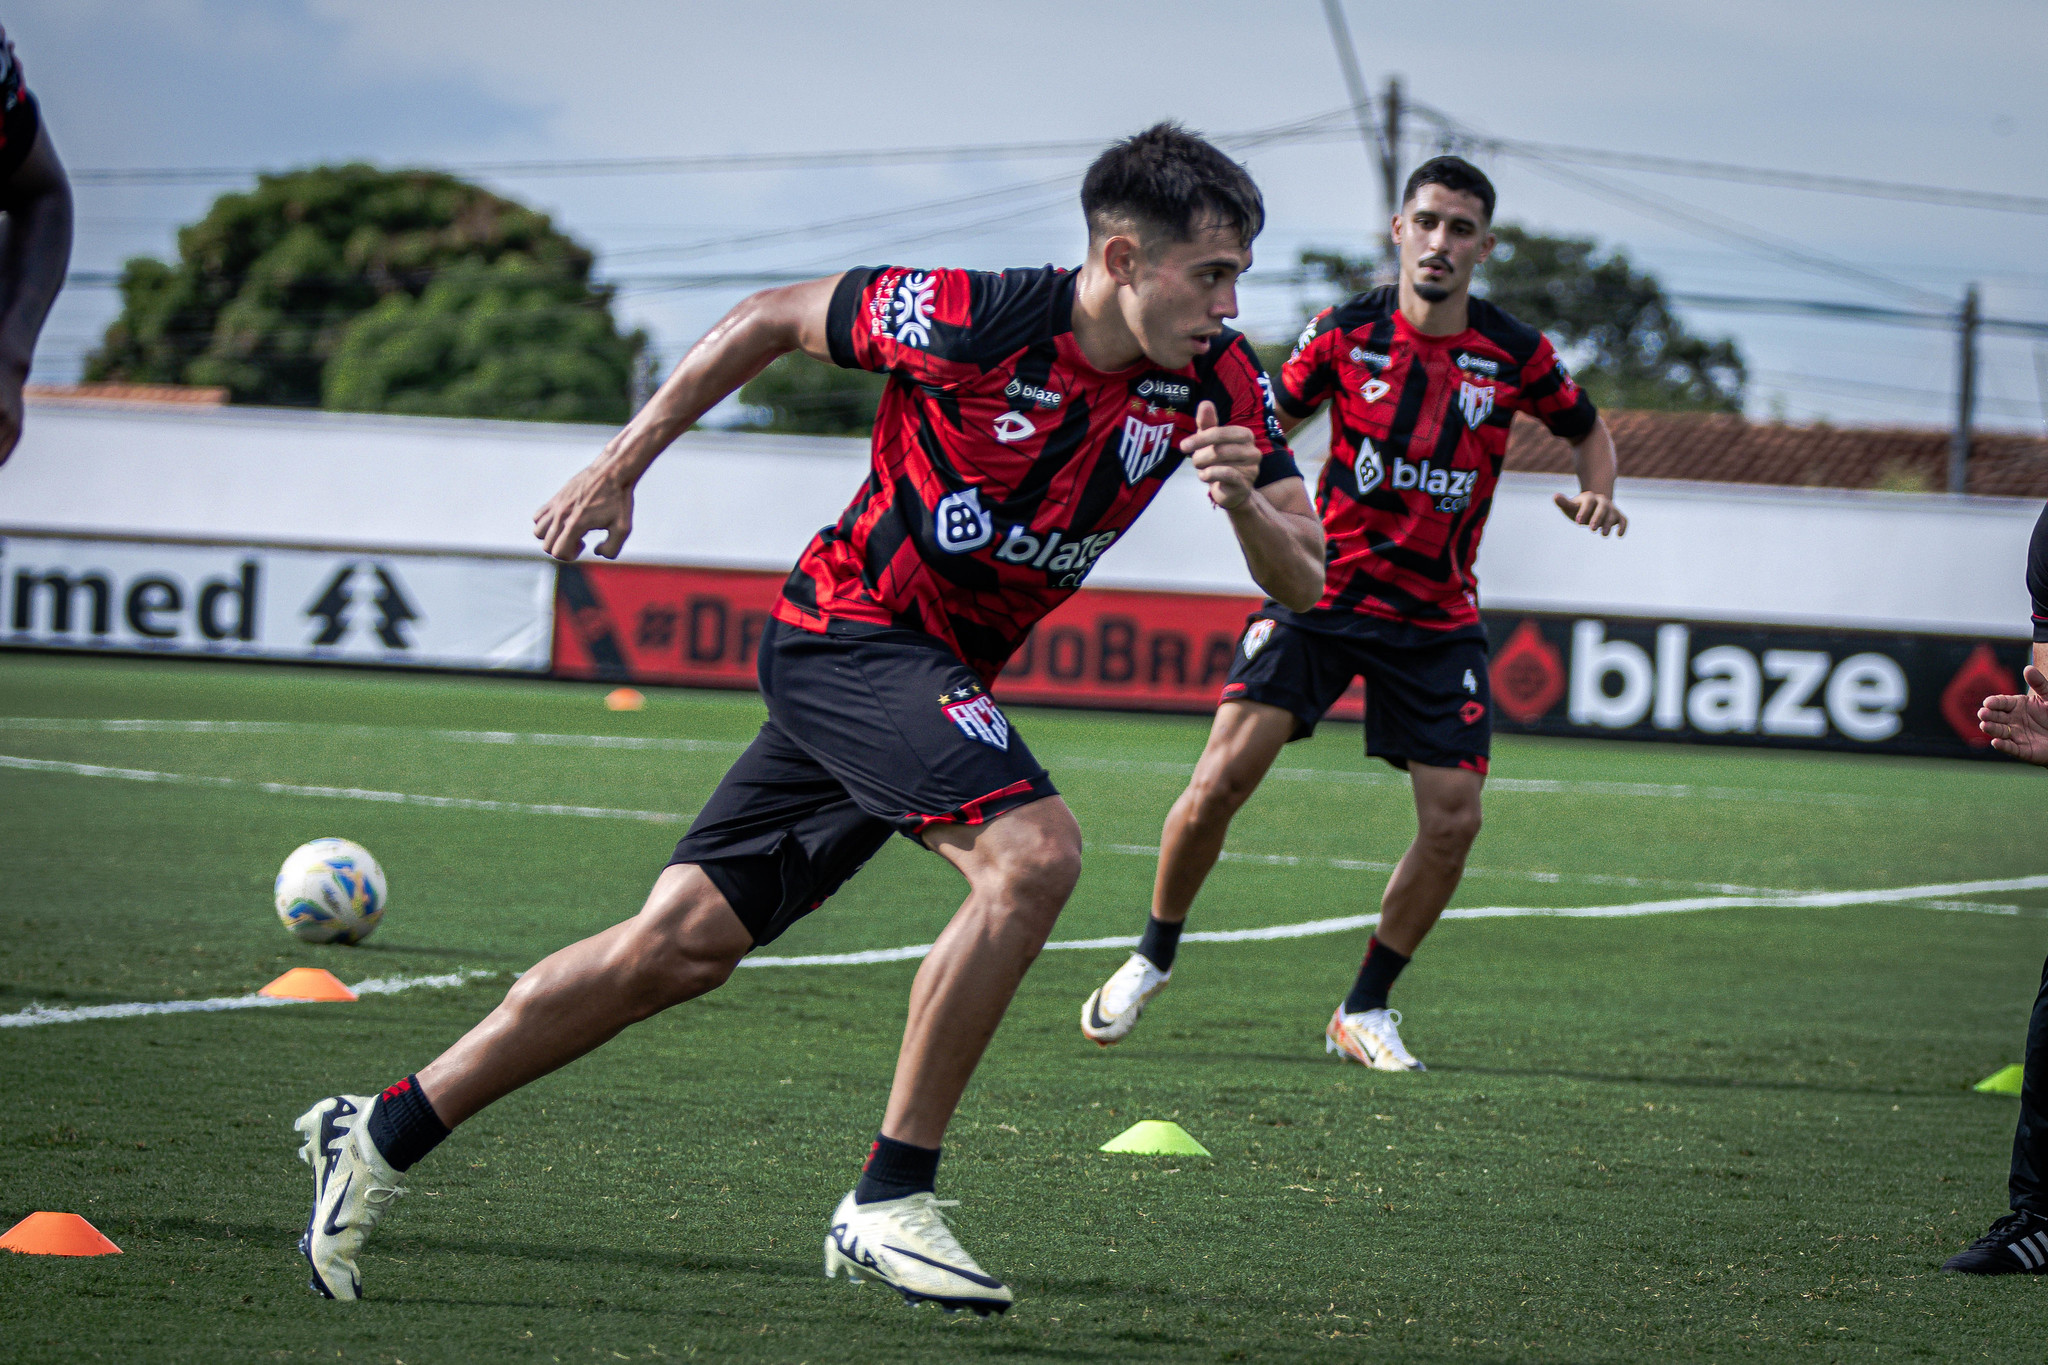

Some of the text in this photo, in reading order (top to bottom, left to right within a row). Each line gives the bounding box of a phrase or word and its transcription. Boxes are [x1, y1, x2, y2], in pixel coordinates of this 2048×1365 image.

[1022, 384, 1062, 403] blaze
[1392, 457, 1478, 496] blaze
[996, 525, 1116, 571] blaze
[0, 556, 259, 643] med
[1462, 668, 1477, 694] 4
[1568, 619, 1908, 742] blaze
